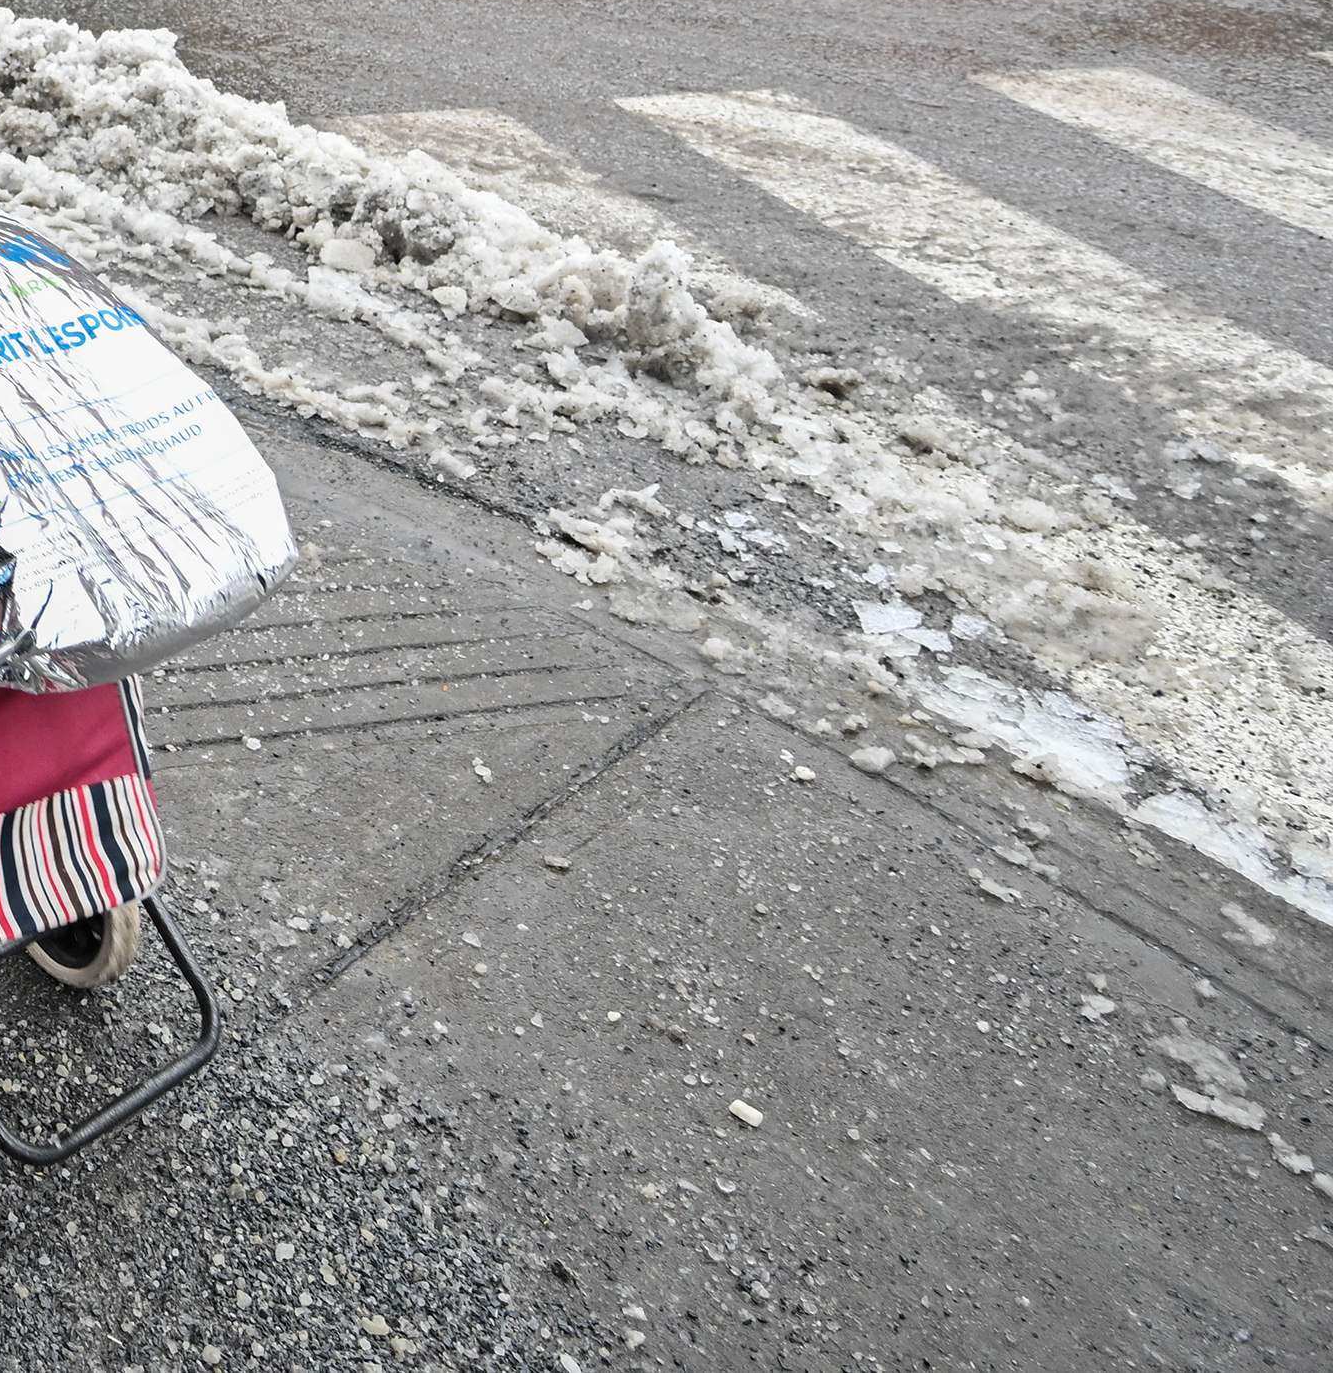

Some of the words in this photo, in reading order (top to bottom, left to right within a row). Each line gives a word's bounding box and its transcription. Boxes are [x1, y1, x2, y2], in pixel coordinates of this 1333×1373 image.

[119, 411, 170, 438] FROIDS
[172, 399, 194, 417] AU
[152, 424, 202, 454] CHAUD
